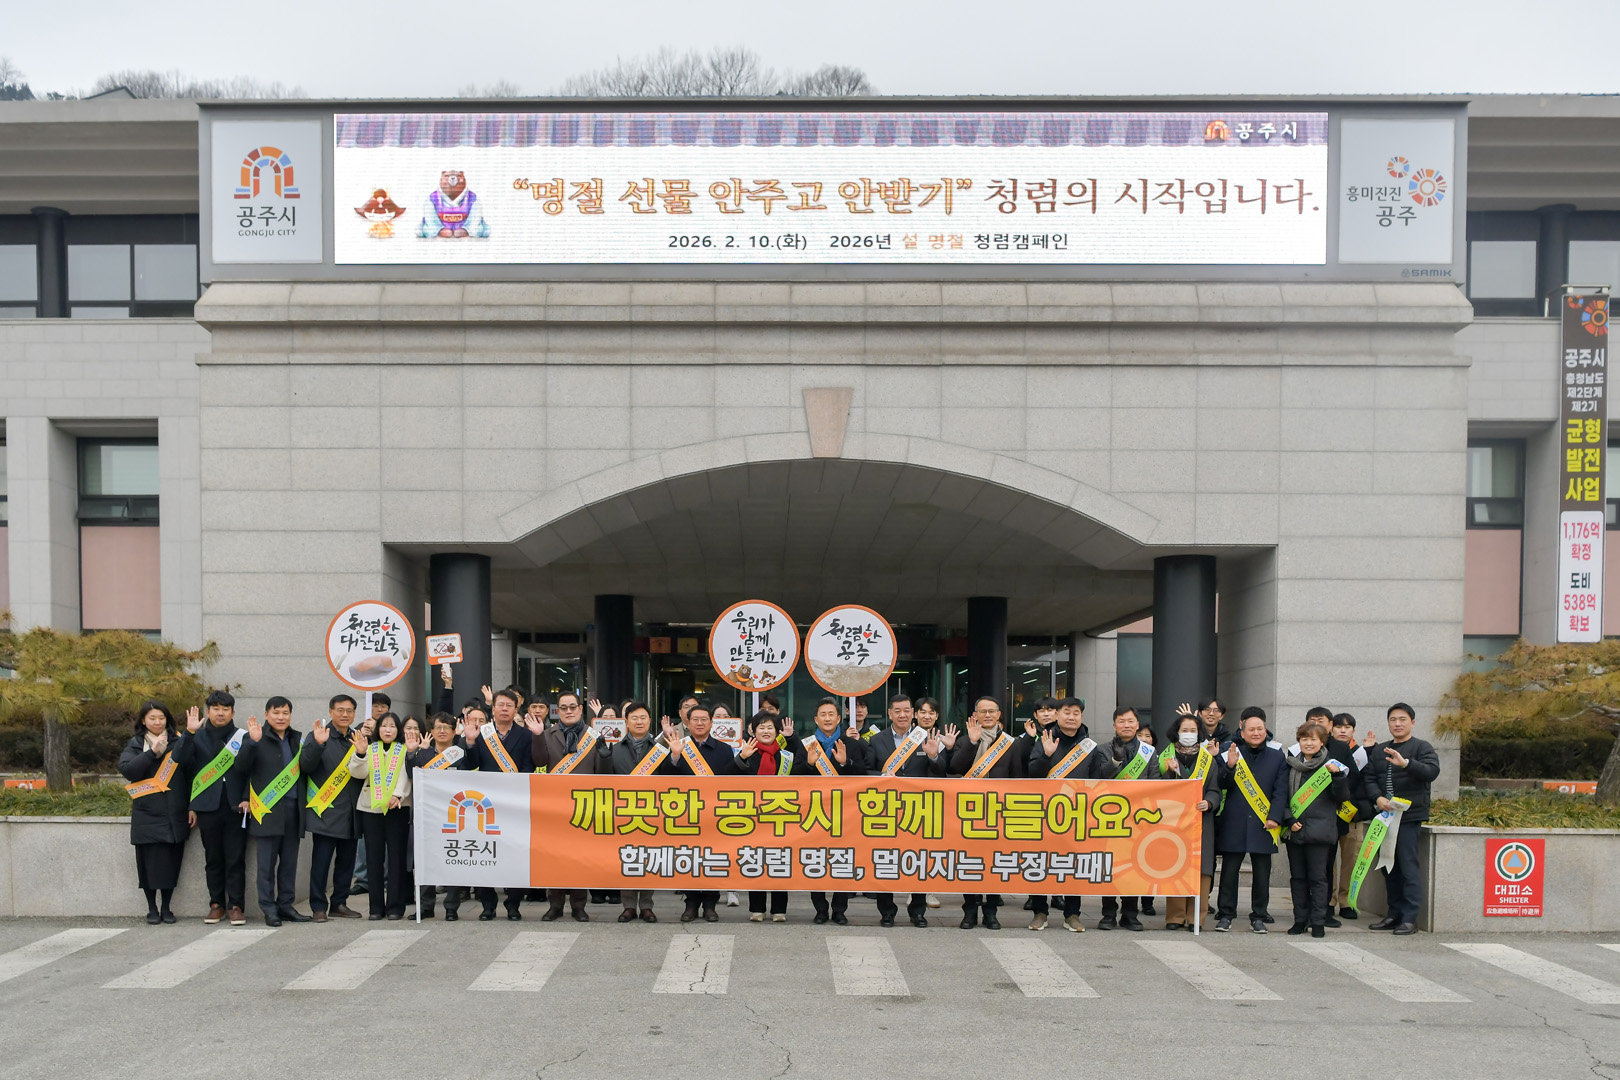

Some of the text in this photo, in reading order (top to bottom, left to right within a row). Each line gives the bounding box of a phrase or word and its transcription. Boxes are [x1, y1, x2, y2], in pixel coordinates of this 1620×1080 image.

[1235, 121, 1297, 140] 공주시
[618, 177, 698, 214] 선물
[708, 178, 827, 215] 안주고
[984, 177, 1097, 215] 청렴의
[1114, 177, 1319, 215] 시작입니다.
[1346, 186, 1401, 202] 흥미진진
[236, 206, 296, 228] 공주시
[1376, 206, 1417, 227] 공주
[238, 229, 275, 238] GONGJU
[668, 233, 1068, 250] 2026. 2. 10.(화) 2026년 설 명절 청렴캠페인
[1411, 269, 1451, 277] SAMIK
[1565, 348, 1605, 368] 공주시
[1565, 372, 1604, 384] 충청남도
[1566, 386, 1602, 398] 제2단계
[1571, 401, 1597, 412] 제2기
[1566, 418, 1601, 443] 균형
[1566, 448, 1600, 472] 발전
[1565, 477, 1600, 501] 사업
[1563, 522, 1600, 540] 1,176억
[1571, 543, 1591, 560] 확정
[1570, 572, 1591, 589] 도비
[1563, 594, 1596, 611] 538억
[341, 613, 400, 636] 청렴한
[731, 611, 775, 631] 우리가
[821, 618, 882, 641] 청렴한
[1569, 615, 1590, 632] 확보
[340, 633, 399, 656] 대한민국
[740, 627, 769, 646] 함께
[730, 645, 786, 664] 만들어요!
[837, 640, 869, 665] 공주
[570, 787, 1163, 841] 깨끗한 공주시 함께 만들어요~
[443, 839, 497, 858] 공주시
[619, 844, 1112, 884] 함께하는 청렴 명절, 멀어지는 부정부패!
[1494, 885, 1533, 895] 대피소
